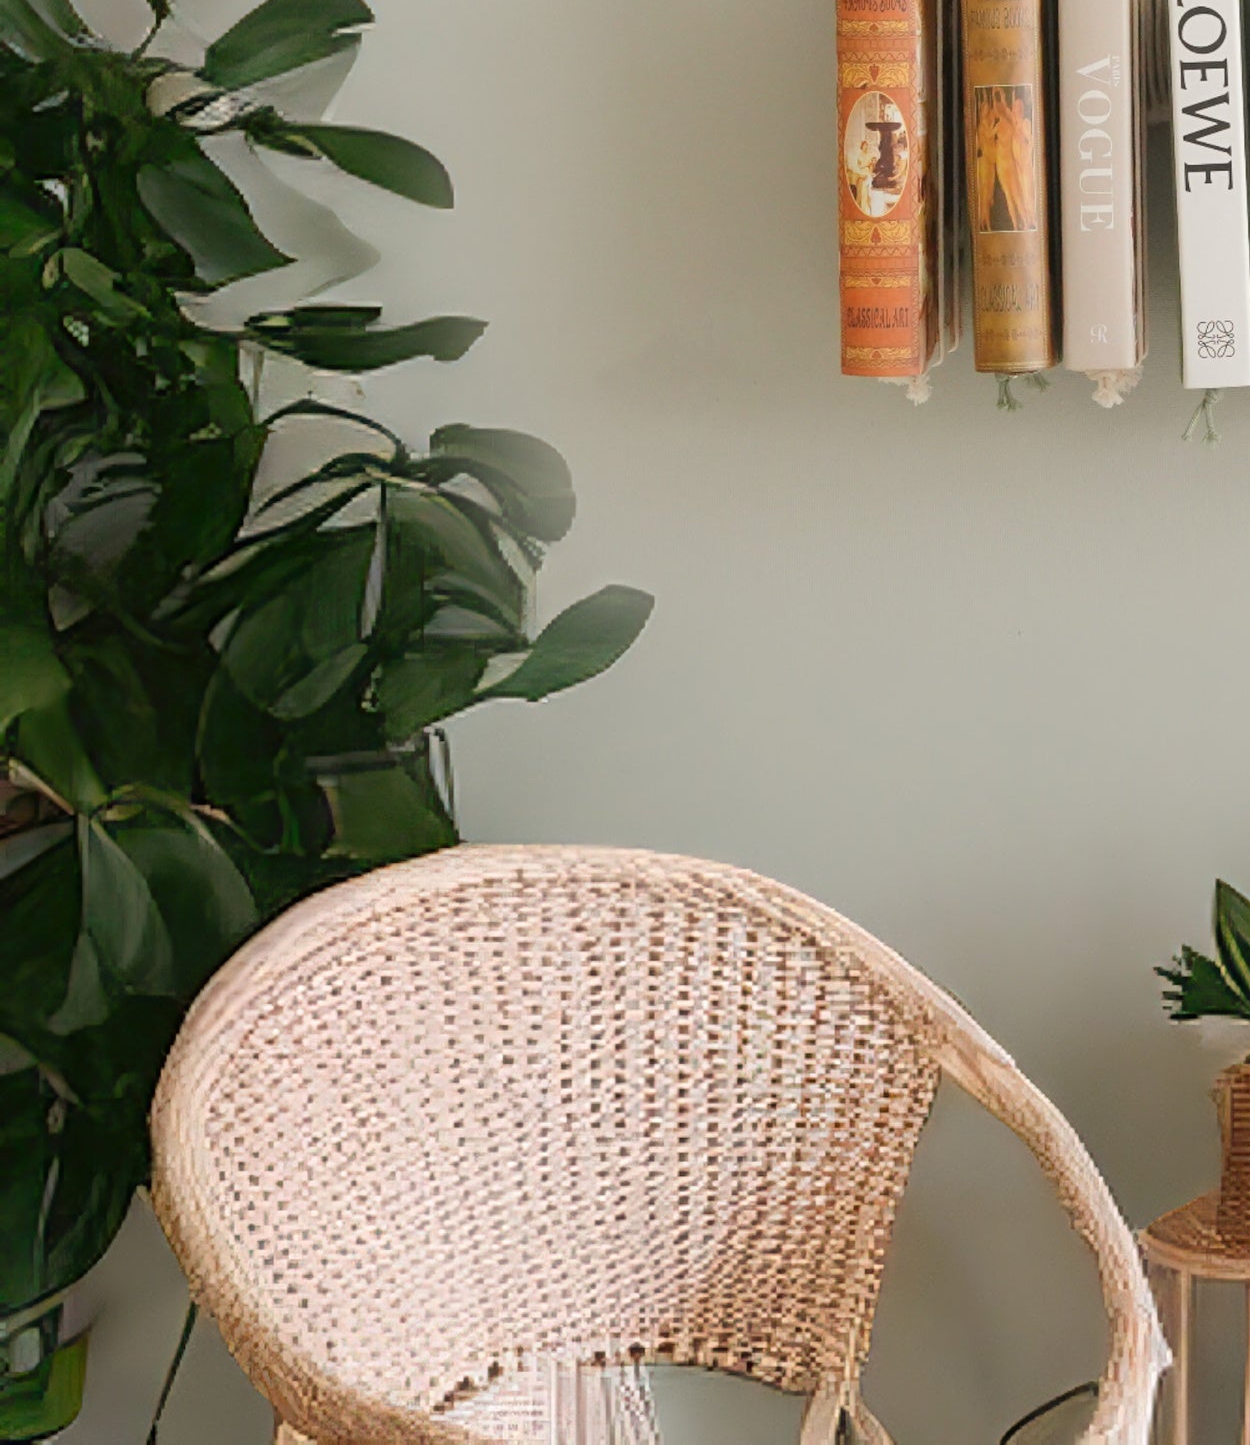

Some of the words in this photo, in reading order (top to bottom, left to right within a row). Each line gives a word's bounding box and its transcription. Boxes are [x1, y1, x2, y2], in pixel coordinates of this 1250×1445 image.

[1076, 54, 1114, 232] VOGUE
[847, 307, 890, 329] CLASSICAL
[891, 307, 909, 328] ART
